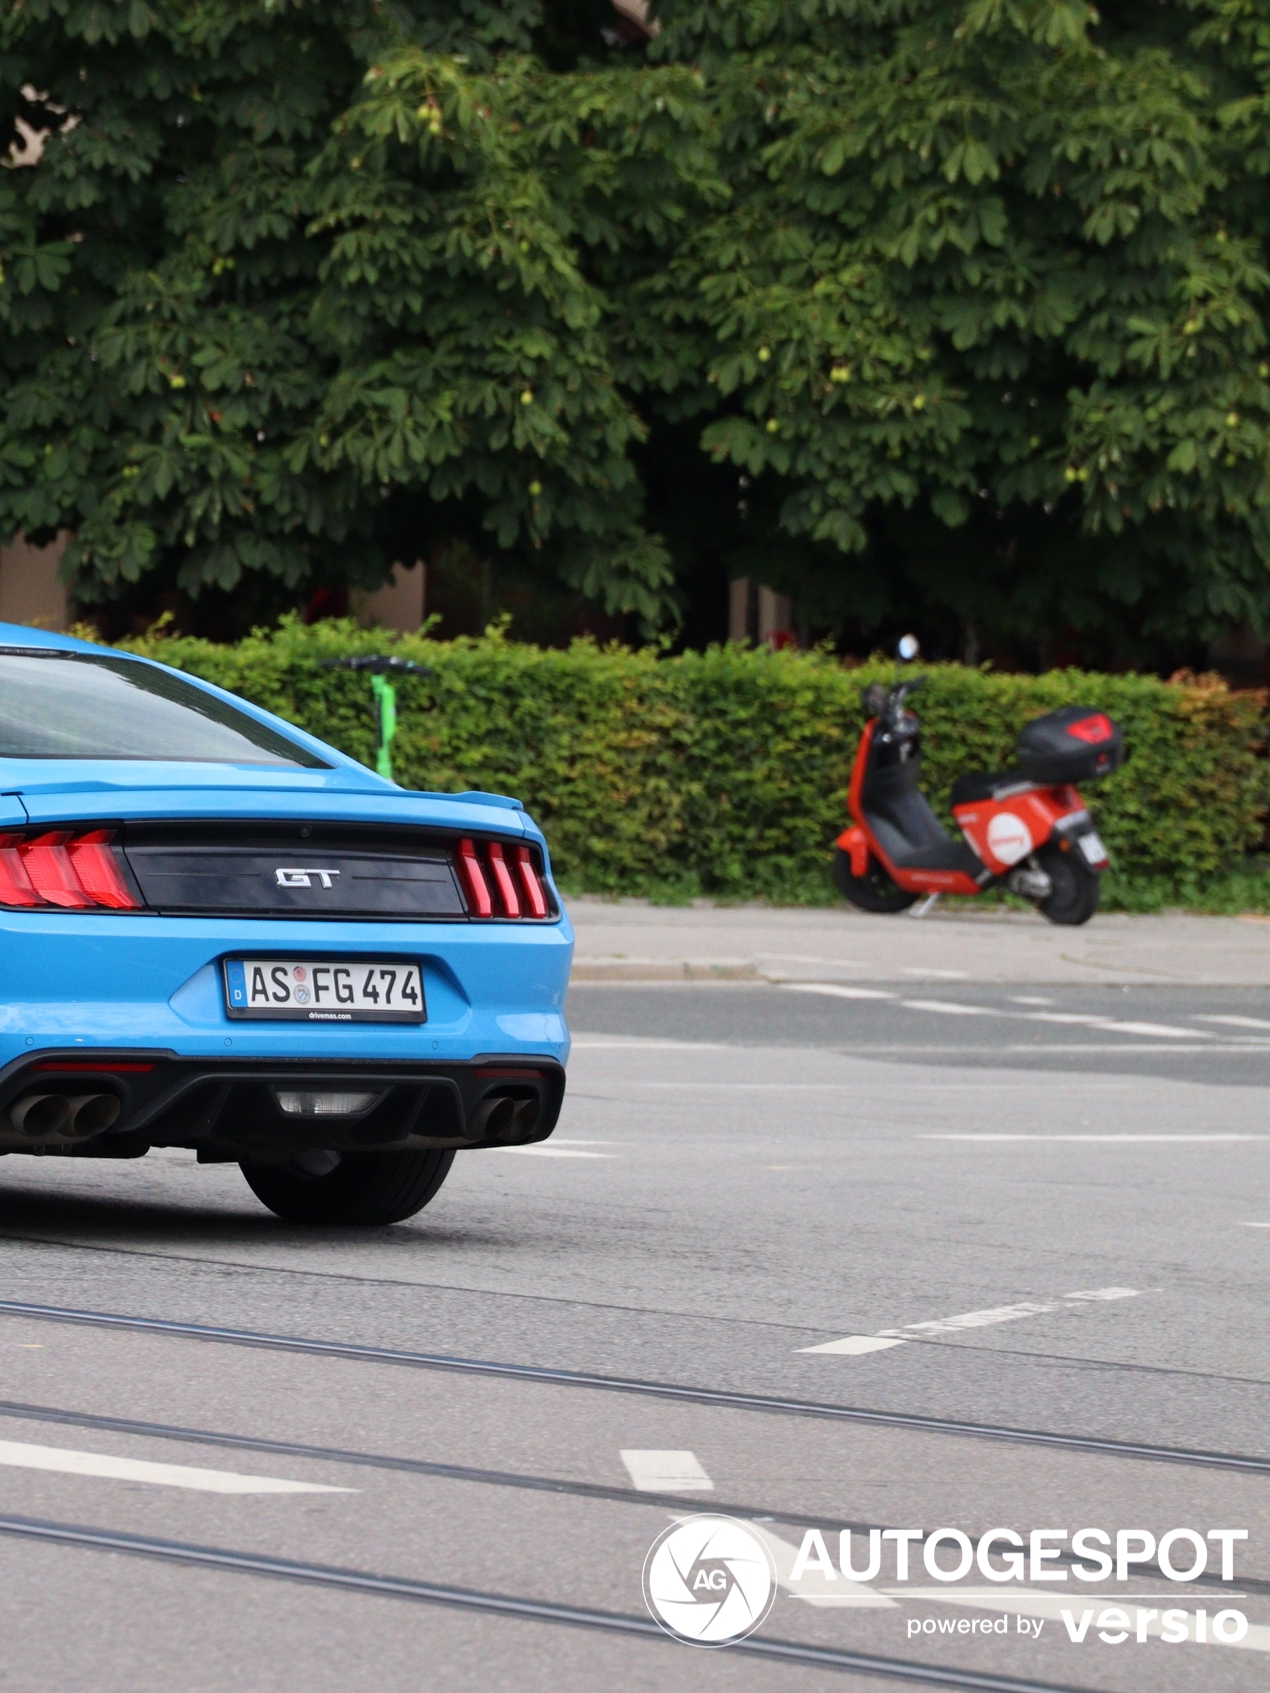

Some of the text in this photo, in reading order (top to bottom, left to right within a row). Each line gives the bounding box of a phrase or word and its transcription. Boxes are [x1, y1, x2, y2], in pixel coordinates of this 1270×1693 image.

[274, 868, 341, 889] GT
[234, 989, 242, 1001] D
[251, 966, 419, 1005] AS FG 474
